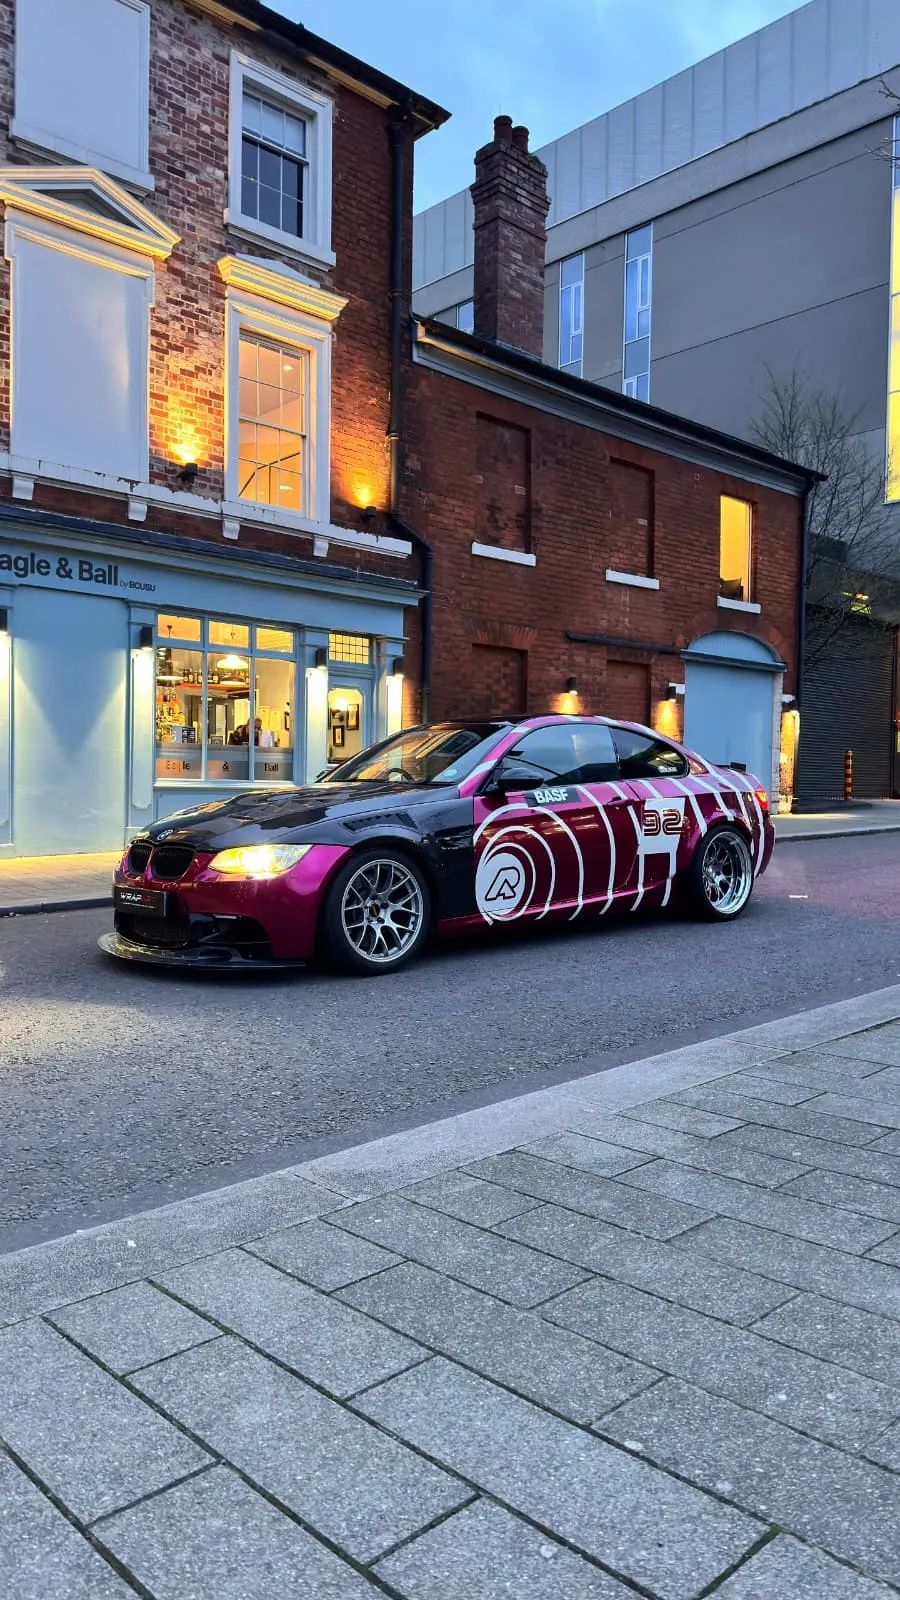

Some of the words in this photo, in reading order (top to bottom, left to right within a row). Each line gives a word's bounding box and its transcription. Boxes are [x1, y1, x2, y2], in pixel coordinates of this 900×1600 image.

[56, 557, 73, 580] &
[78, 559, 119, 586] Ball
[129, 580, 156, 592] BCUSU
[222, 761, 230, 770] &
[264, 762, 279, 772] Ball
[533, 788, 569, 804] BASF
[643, 809, 684, 837] 92
